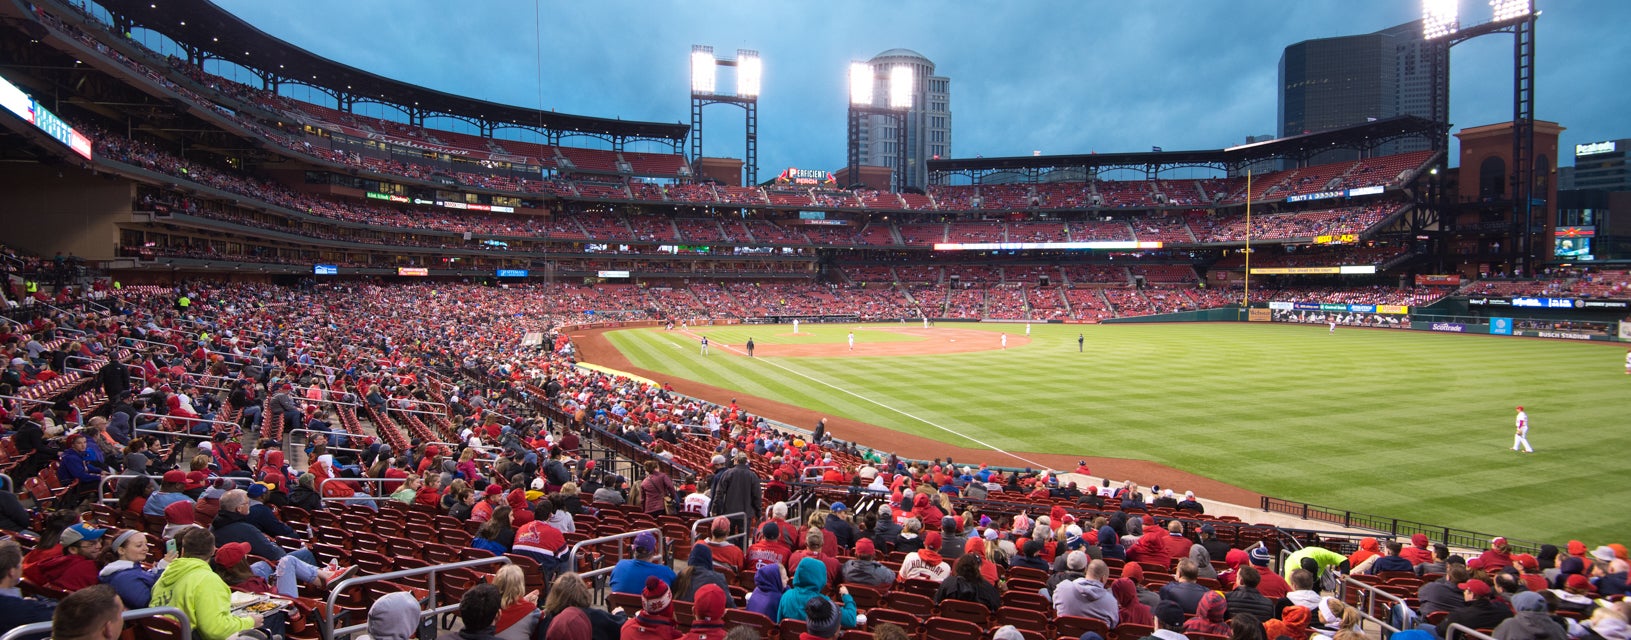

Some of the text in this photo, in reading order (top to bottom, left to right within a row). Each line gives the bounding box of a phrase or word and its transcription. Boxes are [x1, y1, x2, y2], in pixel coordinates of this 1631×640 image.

[367, 132, 471, 155] Budweiser
[789, 168, 825, 179] PERFICIENT
[1317, 235, 1332, 244] BIG
[1432, 323, 1462, 332] Scottrade
[1560, 332, 1590, 340] STADIUM
[911, 559, 944, 576] HOLLIDAY
